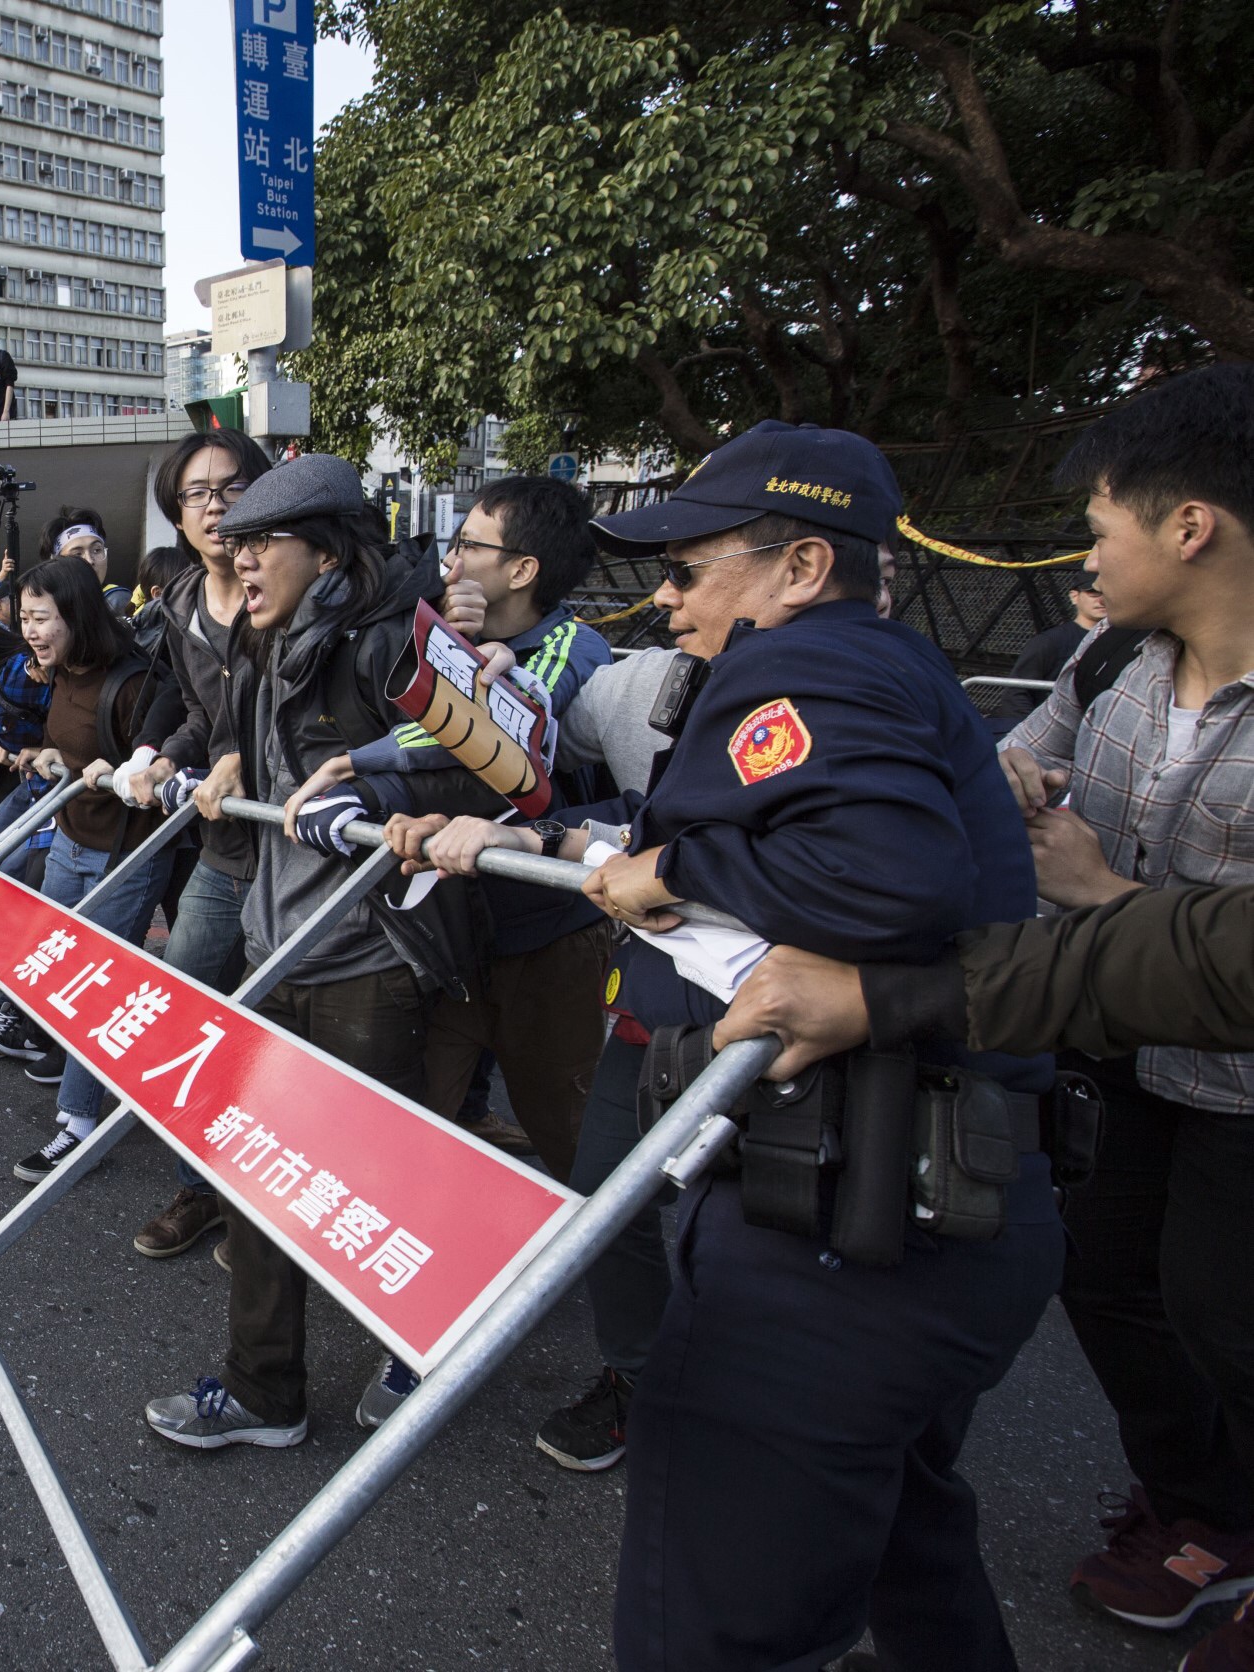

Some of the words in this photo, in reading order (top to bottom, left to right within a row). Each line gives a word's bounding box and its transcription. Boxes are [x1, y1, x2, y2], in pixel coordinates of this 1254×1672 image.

[241, 28, 270, 169] 轉運站
[282, 40, 309, 174] 臺北
[257, 203, 299, 221] Station
[260, 172, 294, 190] Taipei
[266, 189, 288, 204] Bus
[764, 476, 852, 509] 臺北市政府警察局
[12, 927, 226, 1108] 禁止進入
[203, 1105, 435, 1296] 新竹市警察局
